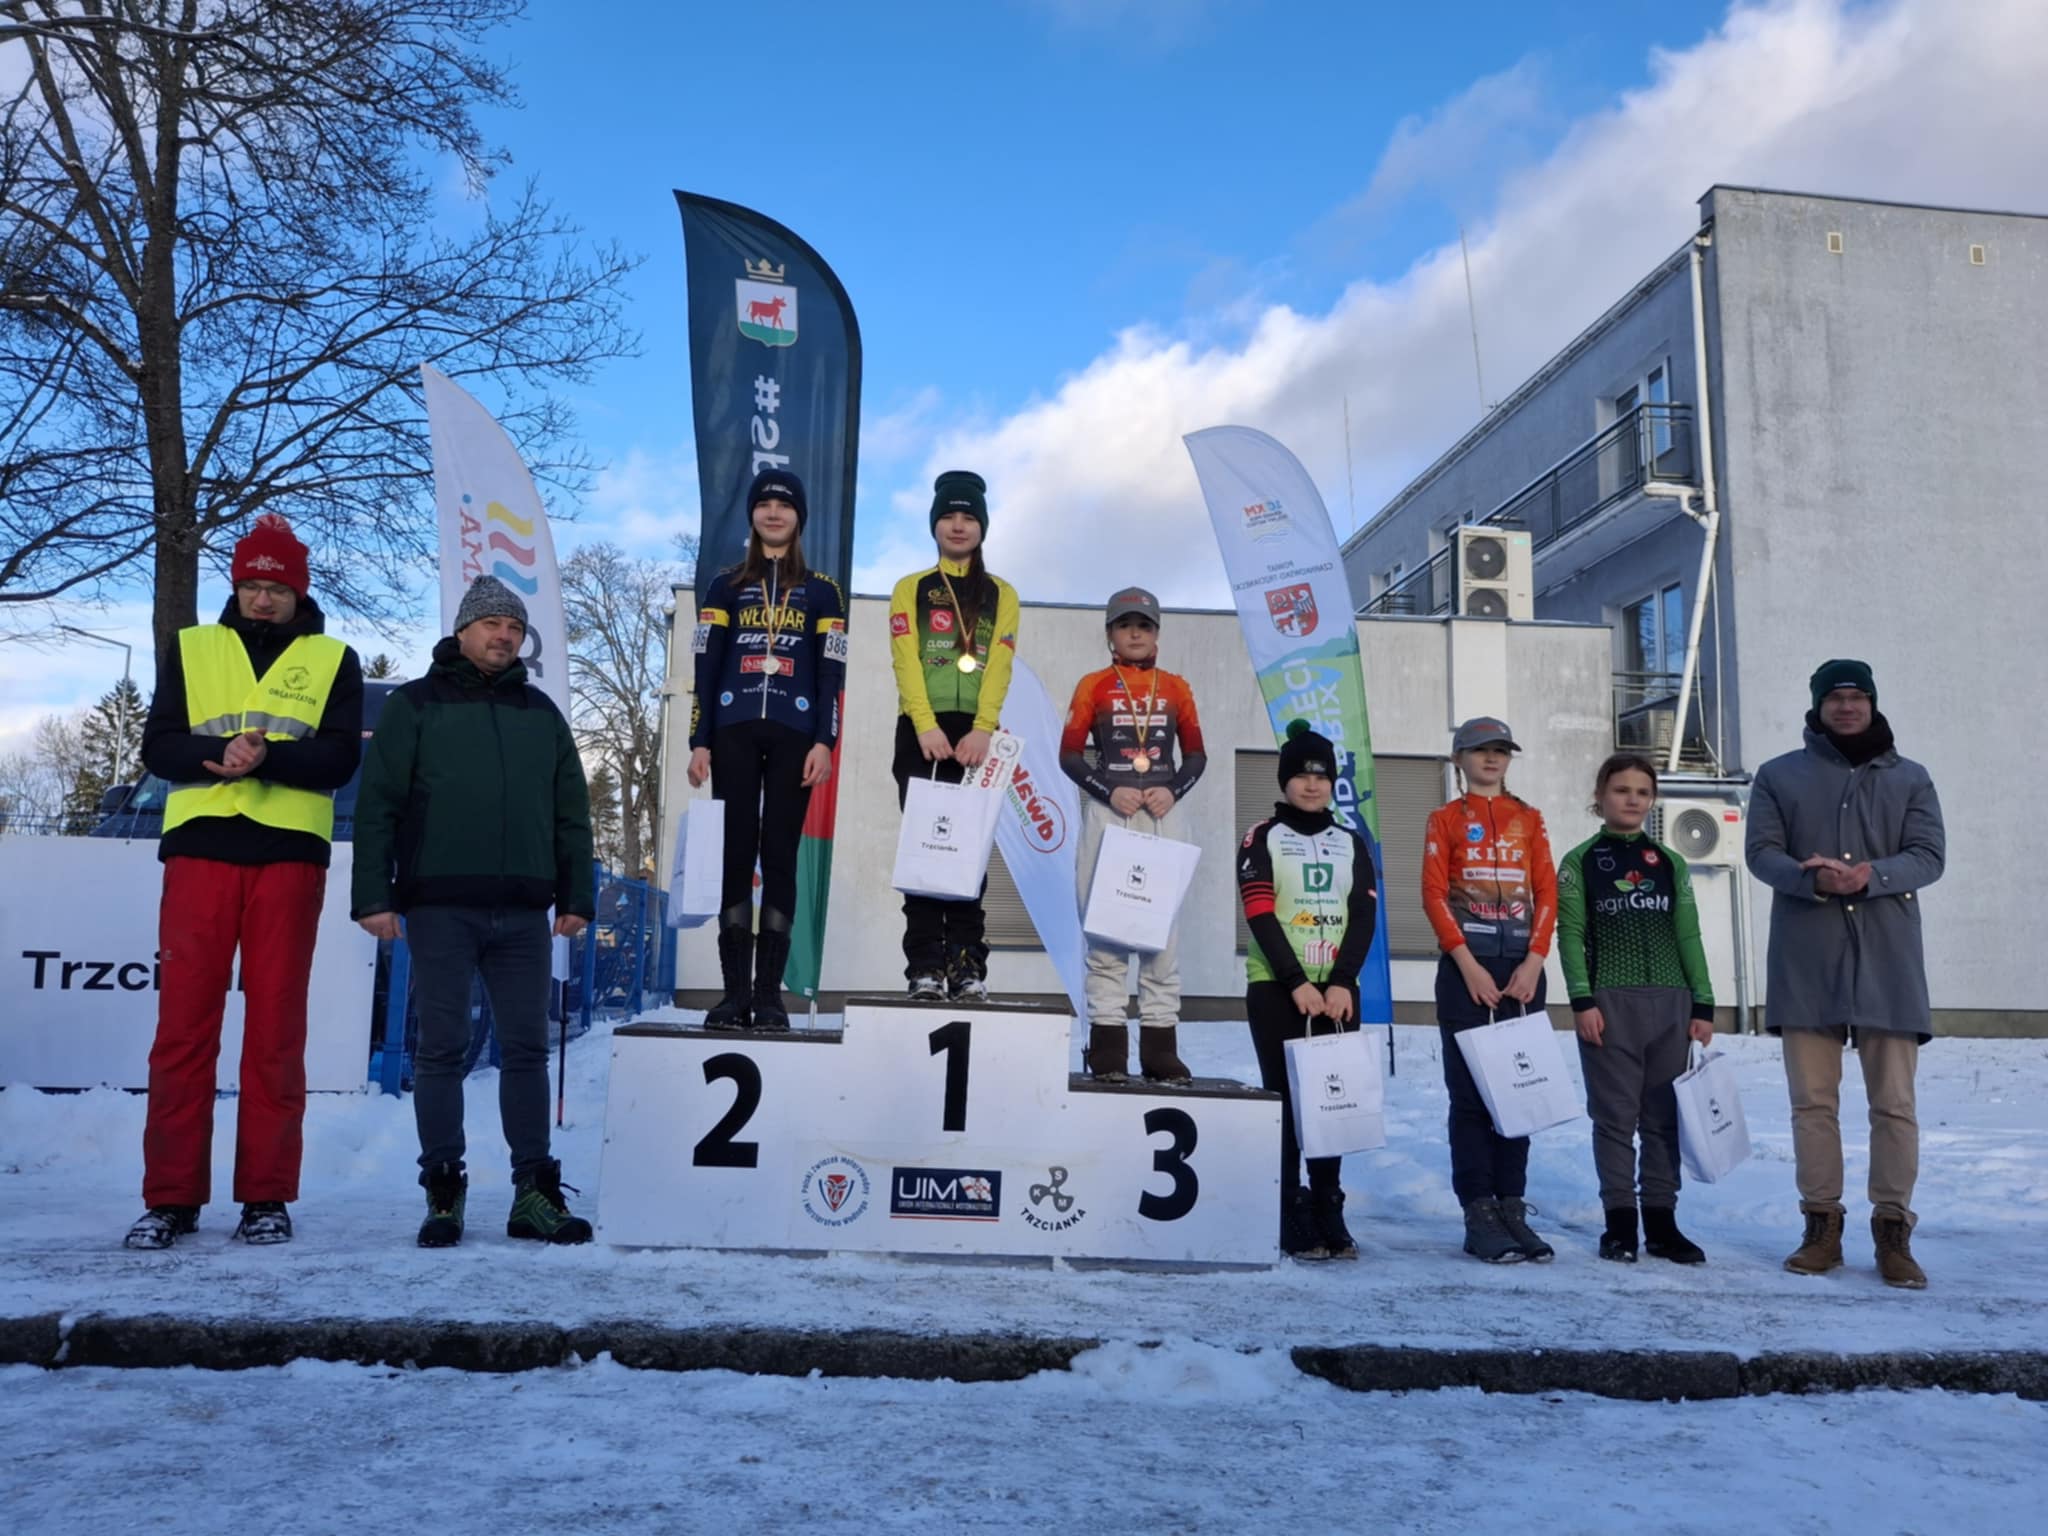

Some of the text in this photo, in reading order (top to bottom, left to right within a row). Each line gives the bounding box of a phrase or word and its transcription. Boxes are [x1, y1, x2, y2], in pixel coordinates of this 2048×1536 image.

[826, 633, 848, 657] 386
[268, 687, 318, 707] ORGANIZATOR
[921, 842, 959, 853] Trzcianka
[1466, 847, 1524, 862] KLIF
[1116, 889, 1152, 904] Trzcianka
[929, 1021, 972, 1132] 1
[1512, 1075, 1550, 1090] Trzcianka
[692, 1052, 763, 1169] 2
[1319, 1102, 1358, 1112] Trzcianka
[1138, 1107, 1199, 1222] 3
[899, 1176, 957, 1201] UIM
[1020, 1207, 1087, 1232] TRZCIANKA
